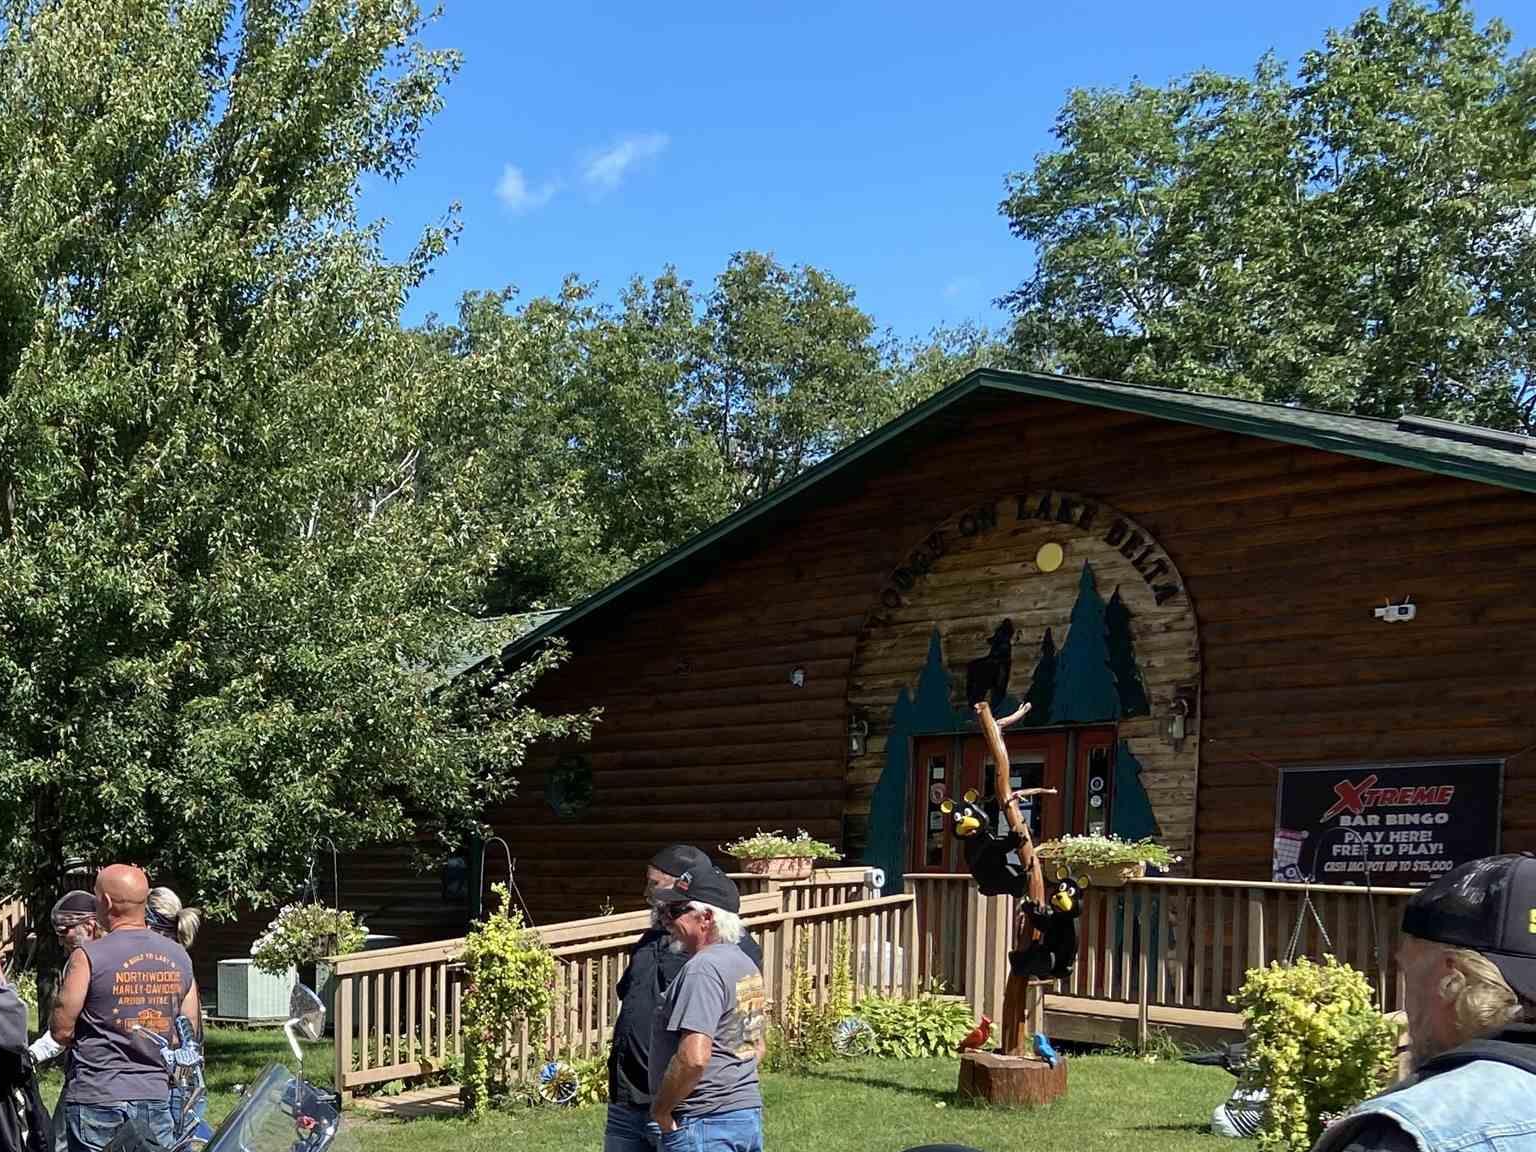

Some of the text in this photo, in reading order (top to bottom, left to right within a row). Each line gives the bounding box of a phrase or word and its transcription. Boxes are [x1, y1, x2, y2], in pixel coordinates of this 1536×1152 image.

[1102, 517, 1179, 606] DELTA
[1340, 812, 1449, 826] BAR BINGO
[1344, 830, 1433, 843] PLAY HERE!
[1332, 843, 1444, 856] FREE TO PLAY!
[1412, 860, 1454, 872] $15,000
